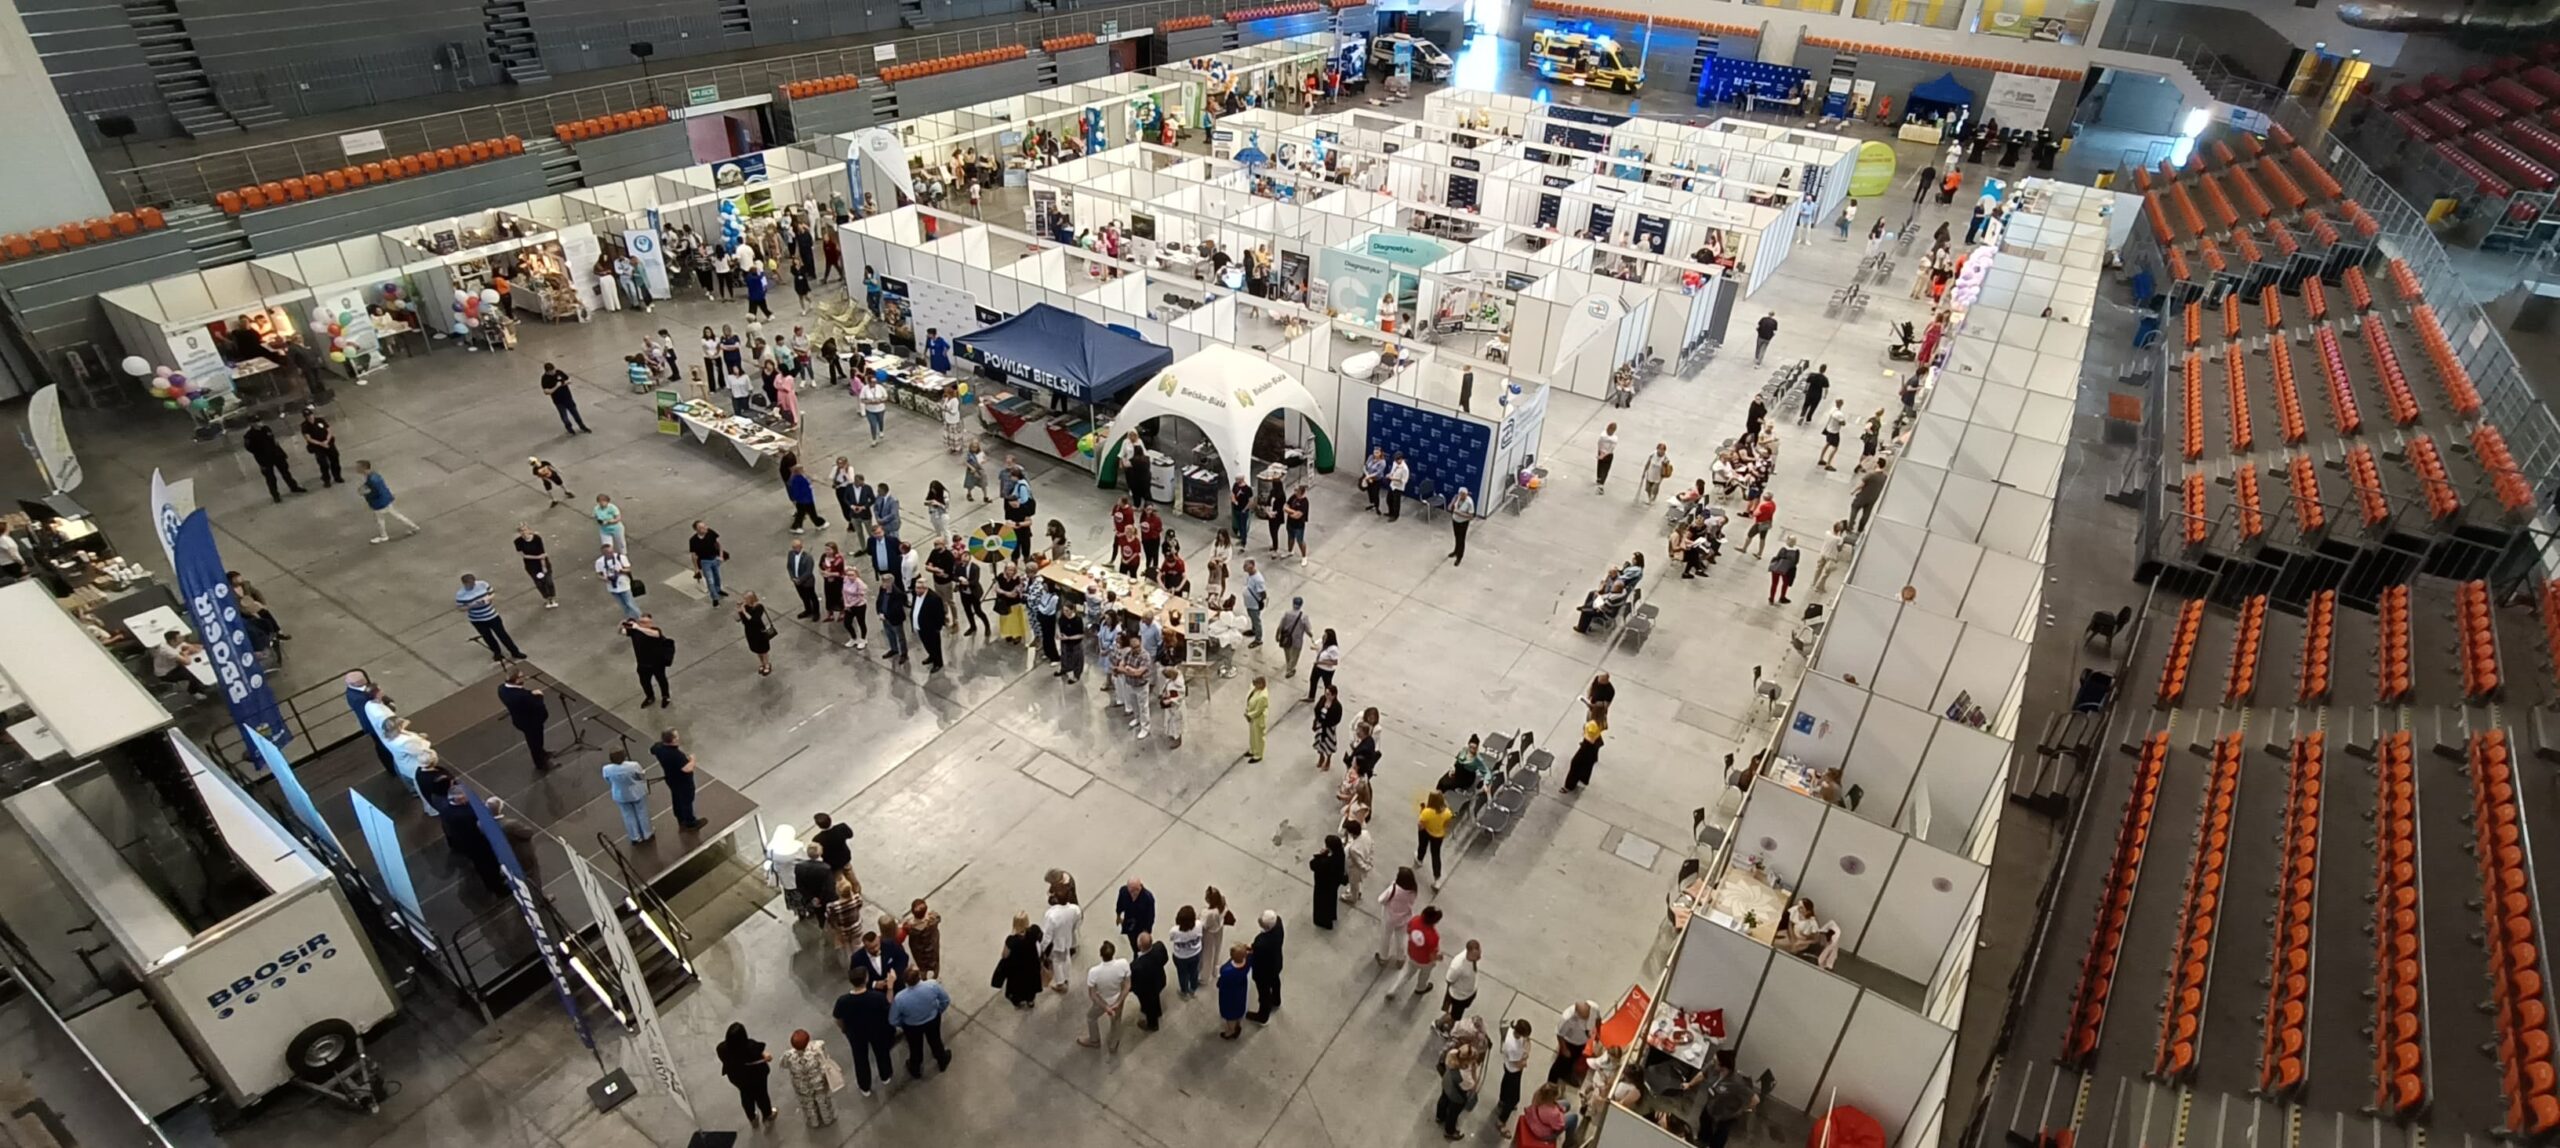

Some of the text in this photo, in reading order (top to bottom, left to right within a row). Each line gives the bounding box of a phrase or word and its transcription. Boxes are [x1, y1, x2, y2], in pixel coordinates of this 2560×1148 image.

[1344, 260, 1381, 274] Diagnostyka
[1373, 242, 1414, 254] Diagnostyka
[984, 351, 1080, 397] POWIAT BIELSKI
[194, 591, 249, 704] BBOSiR
[207, 933, 330, 1009] BBOSiR
